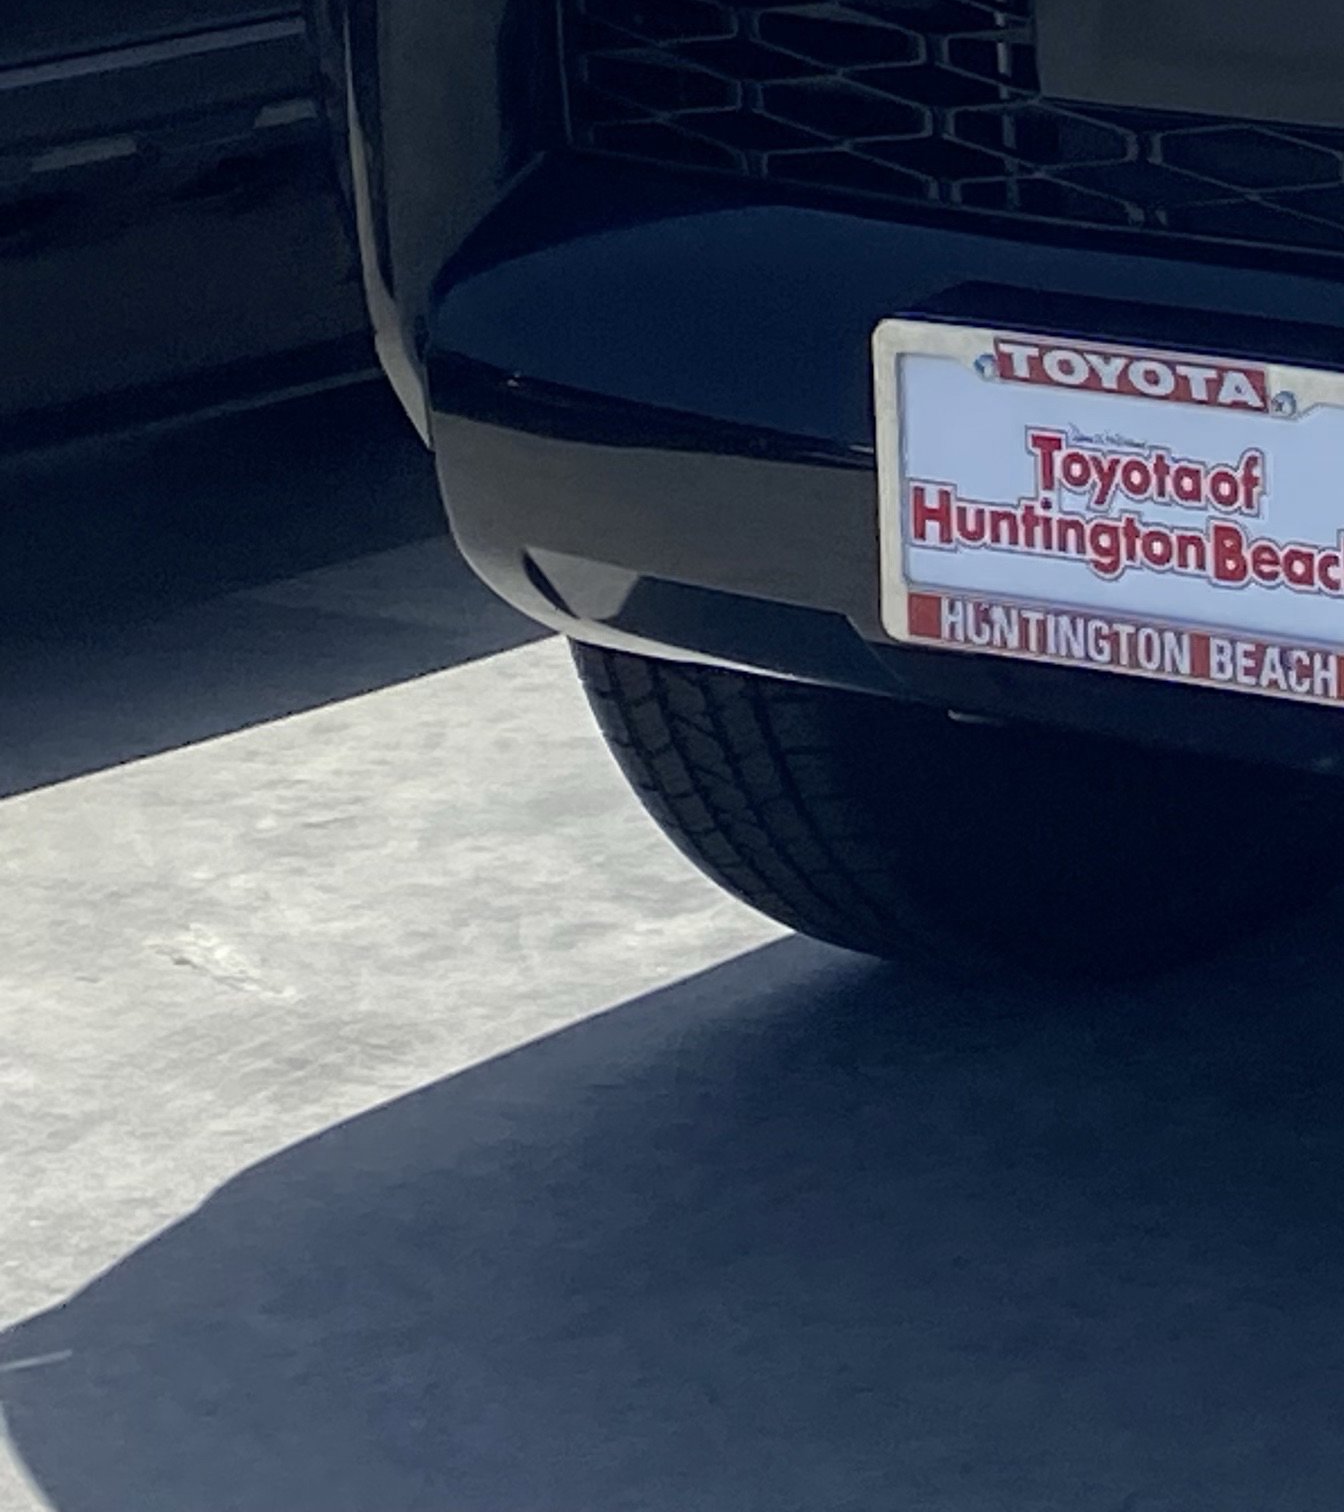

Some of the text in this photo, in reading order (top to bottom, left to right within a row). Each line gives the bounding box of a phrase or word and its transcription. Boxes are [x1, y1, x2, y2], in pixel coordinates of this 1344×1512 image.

[997, 342, 1266, 408] TOYOTA
[1029, 433, 1261, 511] Toyota of
[910, 484, 1207, 575] Huntington
[940, 599, 1340, 699] HUNTINGTON BEACH
